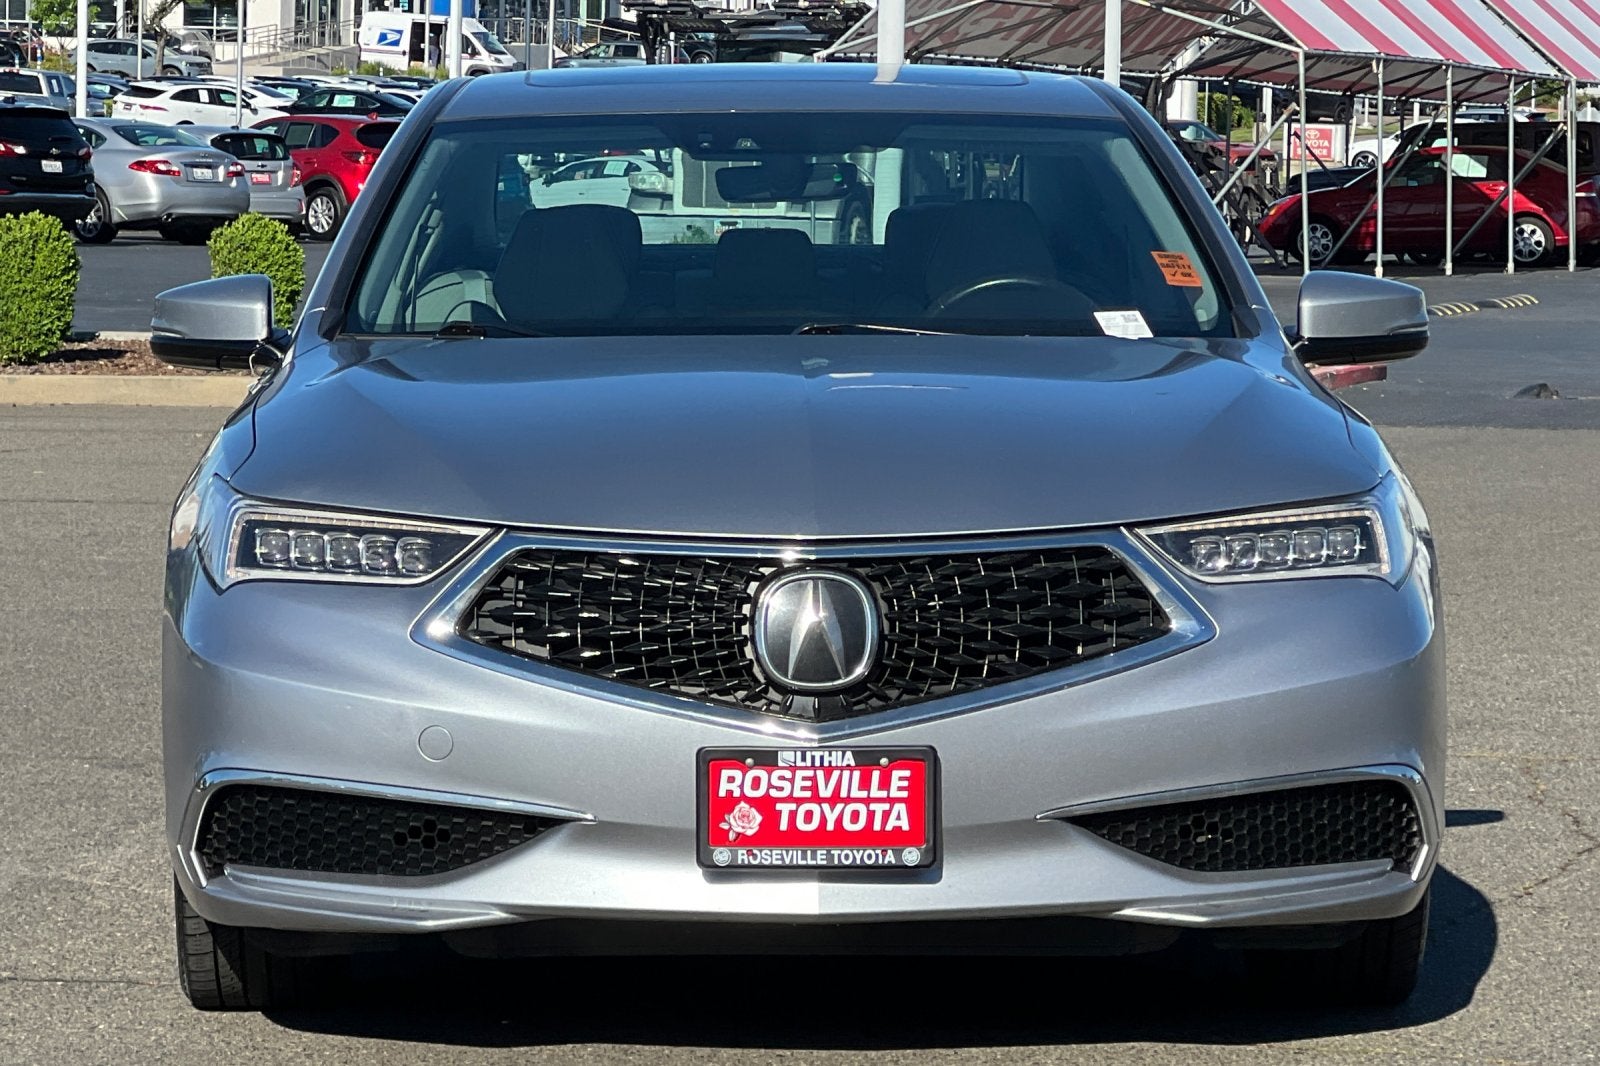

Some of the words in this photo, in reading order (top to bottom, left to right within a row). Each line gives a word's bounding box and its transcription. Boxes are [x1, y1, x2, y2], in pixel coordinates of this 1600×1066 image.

[1295, 139, 1329, 147] TYOTA
[1296, 148, 1328, 156] SICE
[796, 751, 855, 766] LITHIA
[718, 769, 911, 798] ROSEVILLE
[775, 803, 911, 832] TOYOTA
[737, 849, 827, 865] ROSEVILLE
[831, 849, 896, 865] TOYOTA
